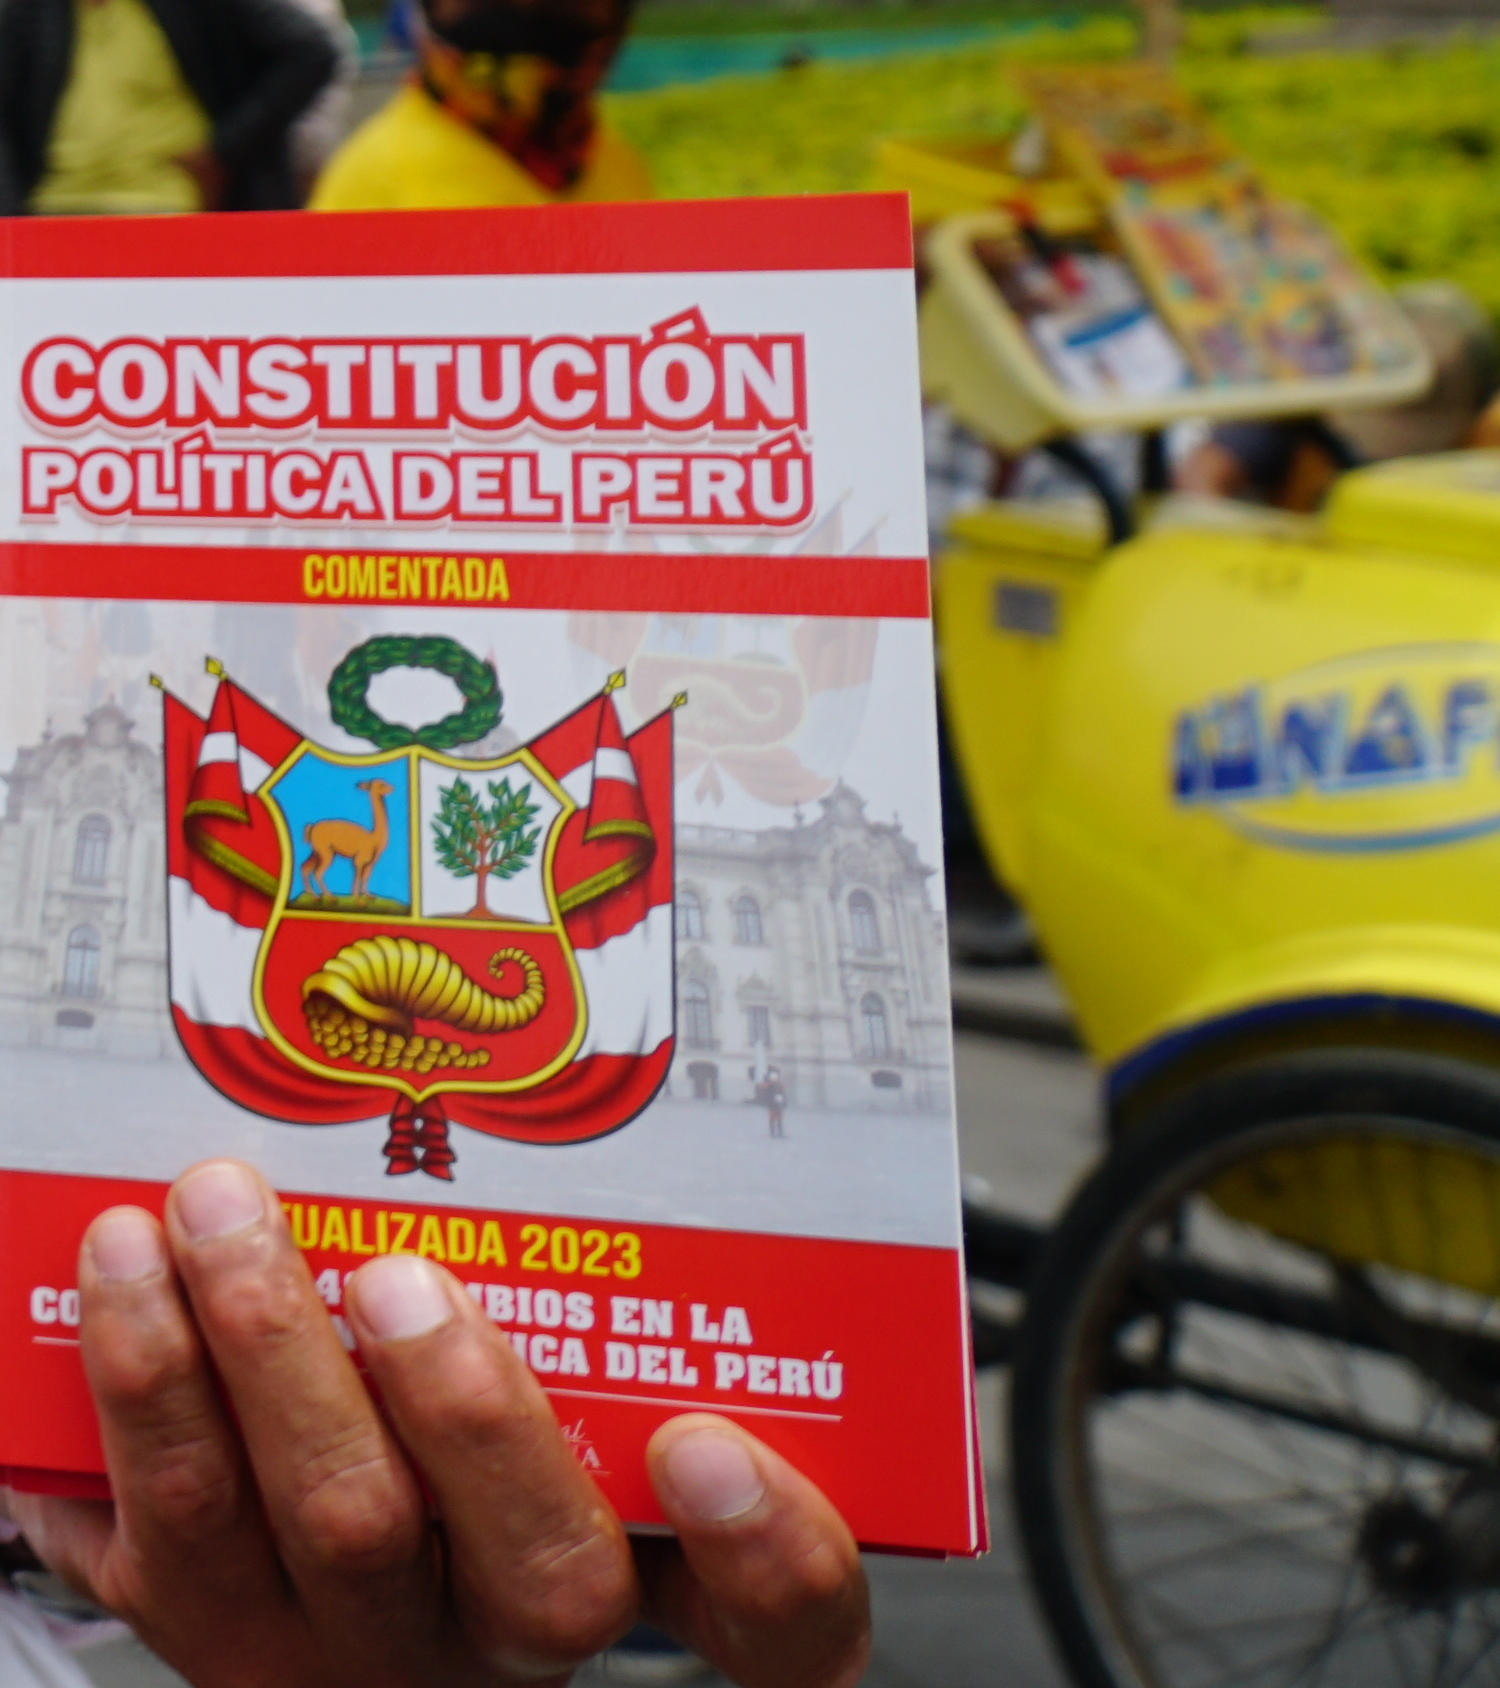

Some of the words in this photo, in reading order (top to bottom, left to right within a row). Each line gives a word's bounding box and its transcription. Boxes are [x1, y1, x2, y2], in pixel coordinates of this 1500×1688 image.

[25, 311, 801, 426] CONSTITUCIÓN
[25, 432, 380, 517] POLÍTICA
[397, 453, 560, 519] DEL
[576, 428, 807, 522] PERÚ
[304, 554, 509, 601] COMENTADA
[520, 1223, 643, 1280] 2023
[610, 1295, 674, 1339] EN
[689, 1302, 753, 1346] LA
[604, 1340, 699, 1388] DEL
[713, 1349, 844, 1401] PERÚ
